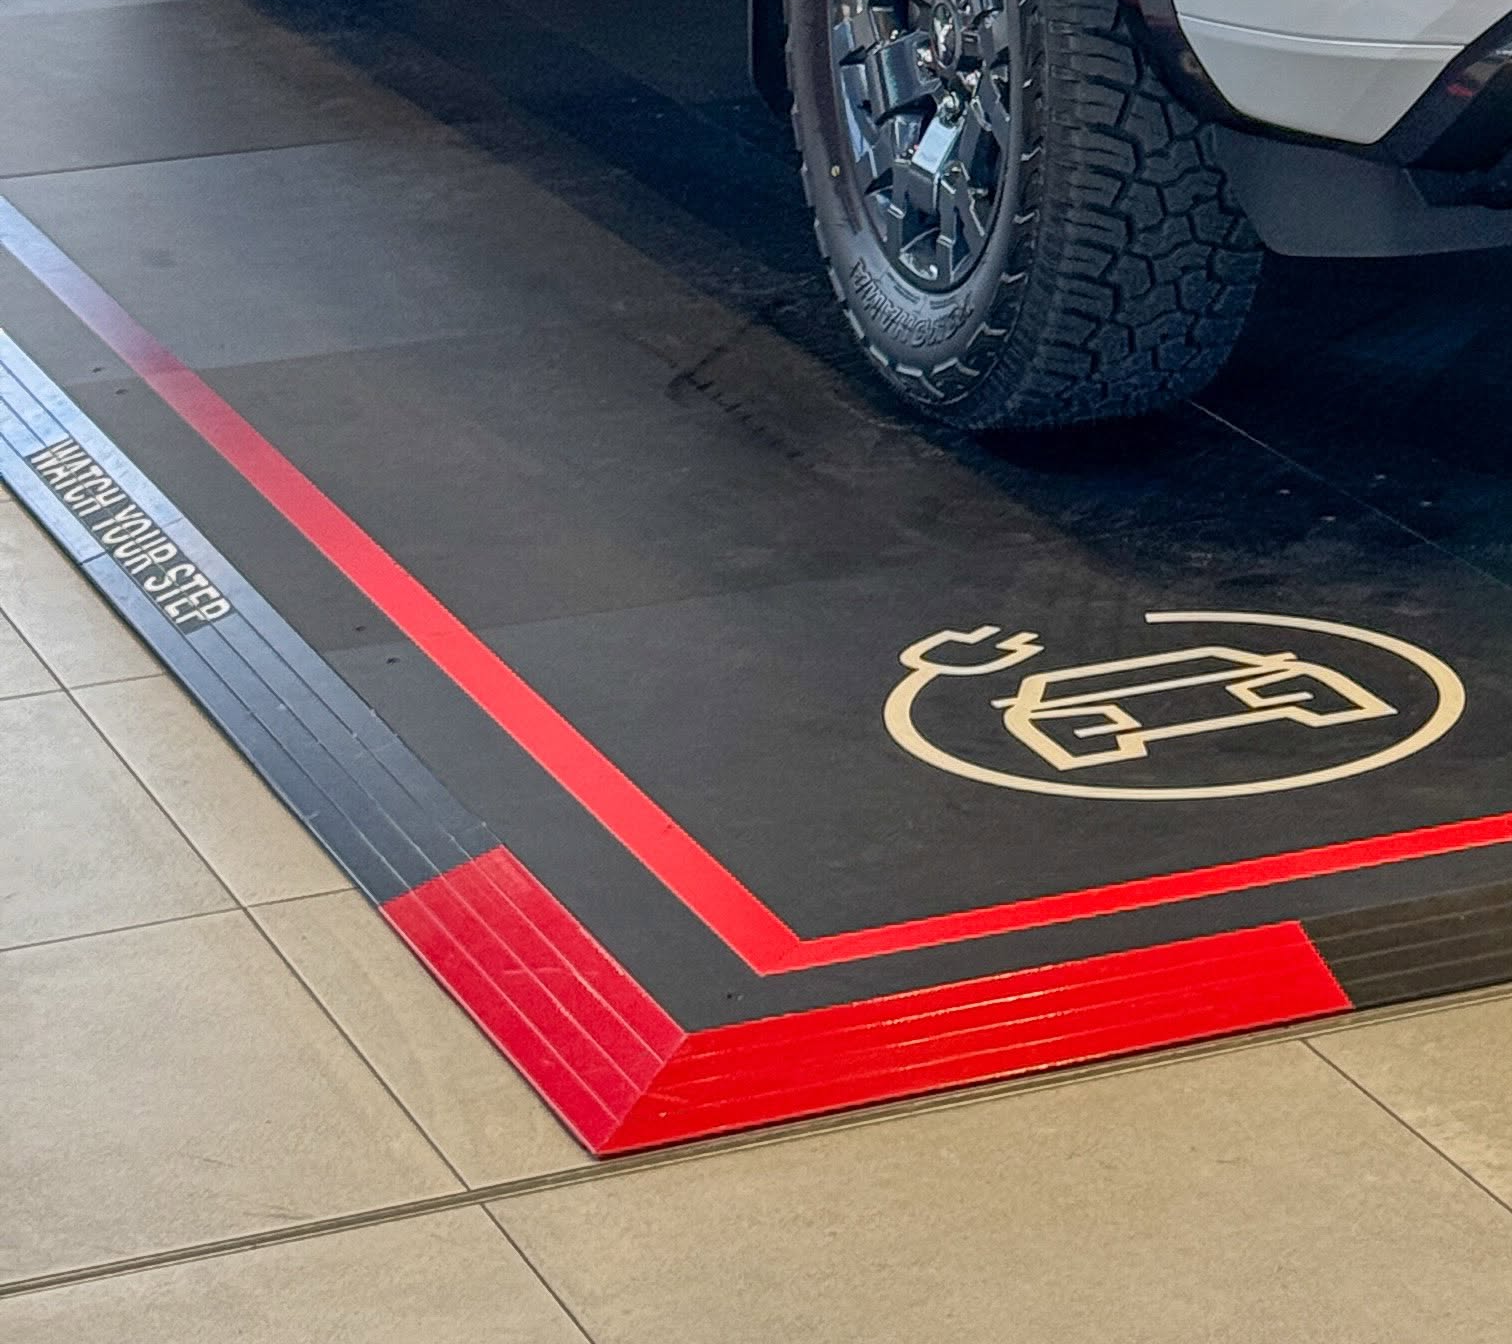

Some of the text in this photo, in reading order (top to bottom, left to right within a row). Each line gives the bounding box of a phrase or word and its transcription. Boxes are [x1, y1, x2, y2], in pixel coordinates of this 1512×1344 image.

[30, 438, 231, 624] WATCH YOUR STEP
